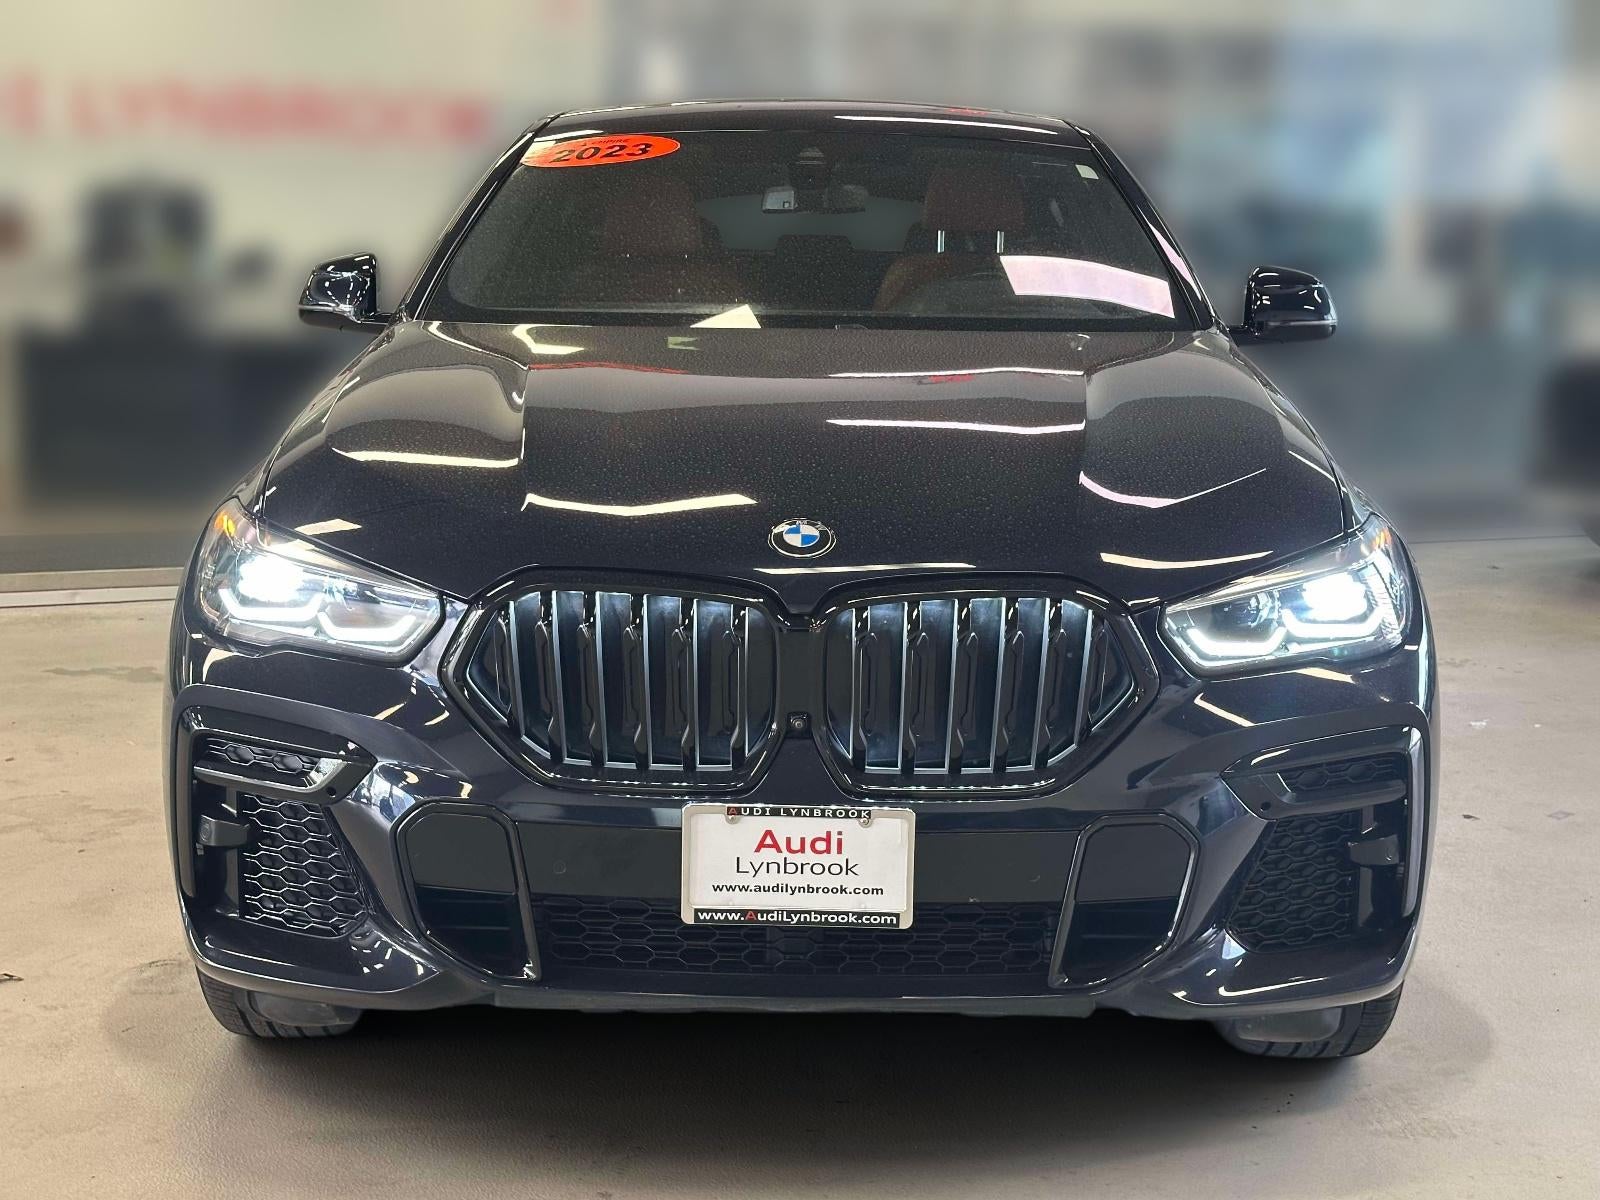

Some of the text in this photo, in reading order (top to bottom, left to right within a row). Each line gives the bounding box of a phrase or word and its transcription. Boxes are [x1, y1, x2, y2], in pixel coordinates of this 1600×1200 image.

[550, 143, 653, 163] 2023
[728, 806, 871, 819] AUDI LYNBROOK
[754, 829, 843, 855] Audi
[736, 857, 860, 878] Lynbrook
[712, 883, 884, 896] www.audilynbrook.com
[698, 910, 897, 924] www.AudiLynbrook.com
